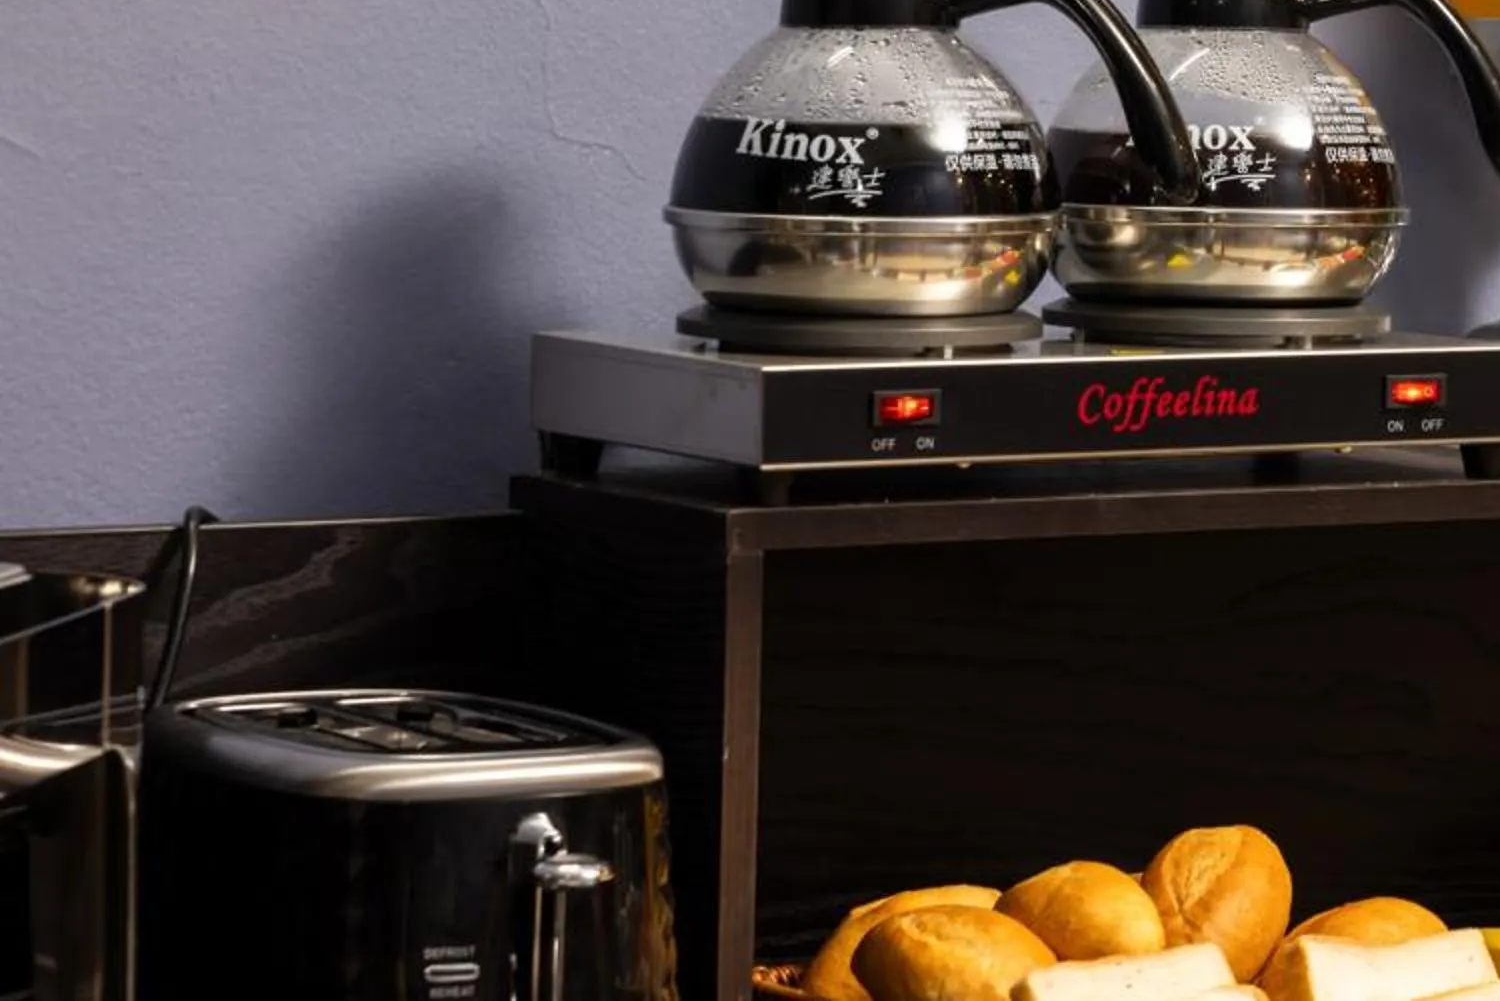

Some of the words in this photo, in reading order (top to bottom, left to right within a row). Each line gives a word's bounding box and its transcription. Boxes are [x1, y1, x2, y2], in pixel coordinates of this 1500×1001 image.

[735, 116, 866, 165] Kinox
[1077, 374, 1260, 433] Coffeelina
[1386, 419, 1405, 433] ON
[1421, 418, 1446, 433] OFF
[871, 437, 897, 452] OFF
[915, 435, 935, 451] ON
